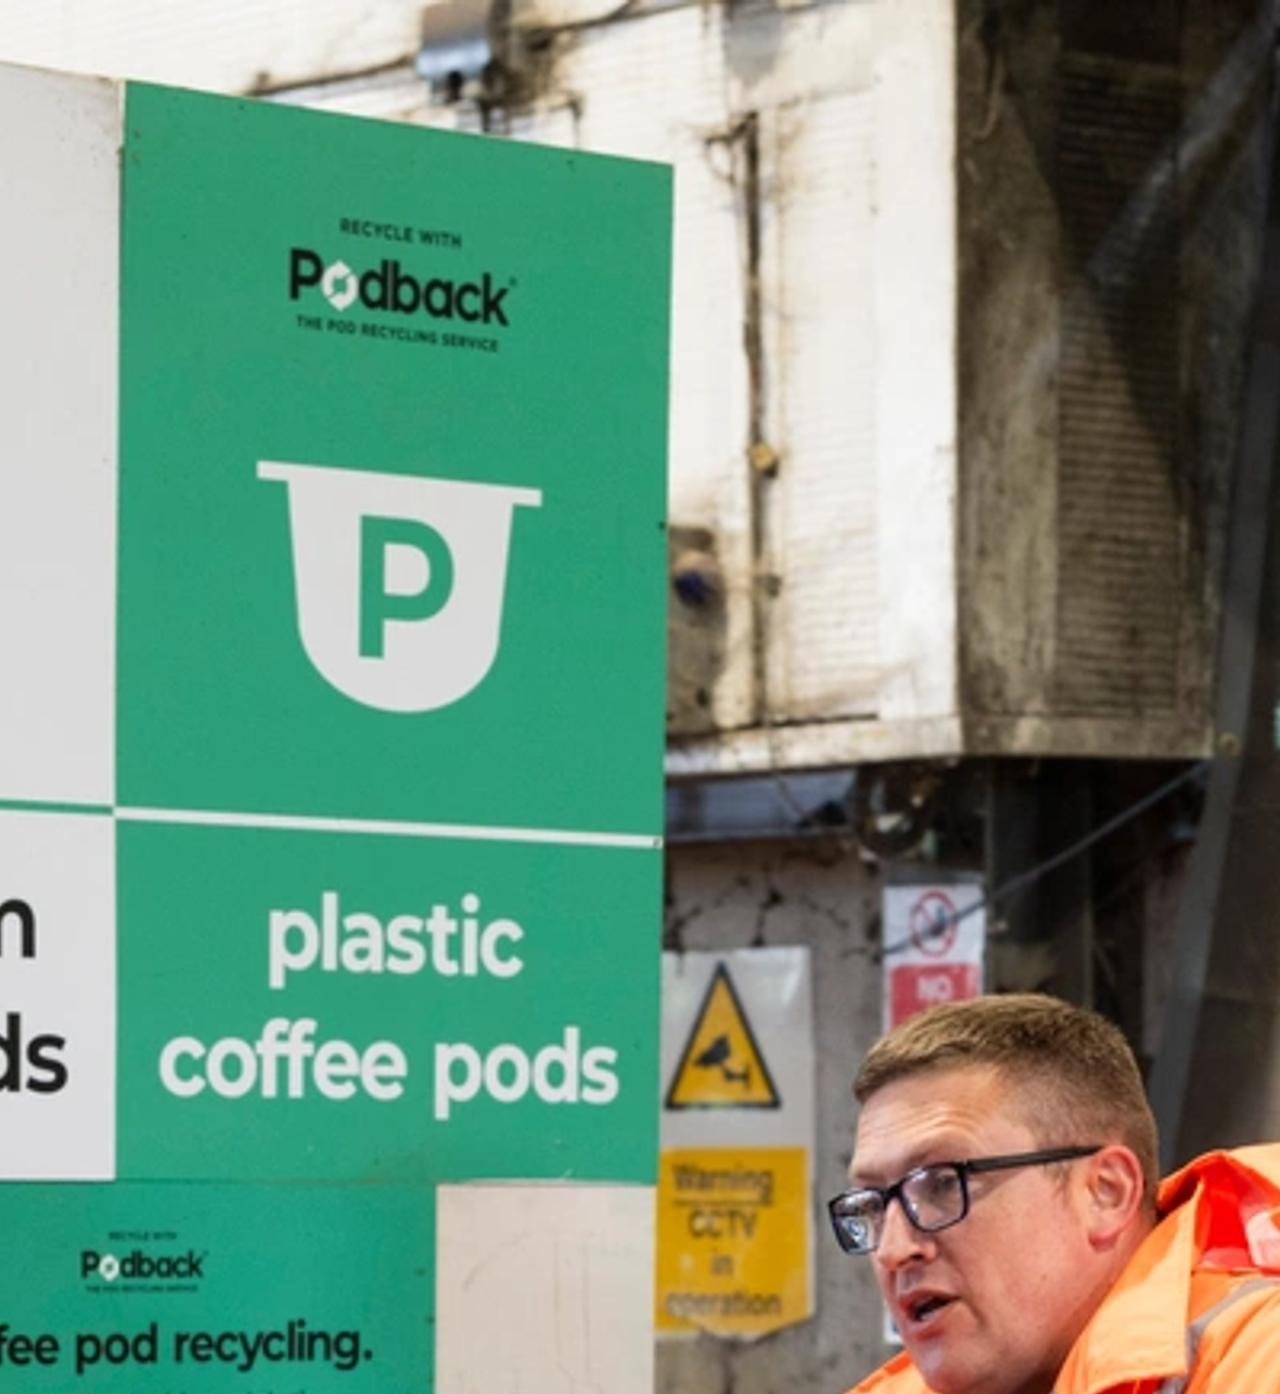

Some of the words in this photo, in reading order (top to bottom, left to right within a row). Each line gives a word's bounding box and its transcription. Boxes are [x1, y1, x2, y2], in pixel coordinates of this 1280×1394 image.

[339, 217, 415, 243] RECYCLE
[420, 230, 462, 248] WITH
[289, 247, 510, 328] Podback
[296, 314, 323, 331] THE
[326, 319, 357, 335] POD
[361, 322, 438, 346] RECYCLING
[441, 332, 499, 353] SERVICE
[358, 513, 455, 660] P
[268, 891, 524, 990] plastic
[158, 1017, 408, 1100] coffee
[434, 1025, 619, 1121] pods
[672, 1164, 775, 1206] Warning
[687, 1209, 758, 1240] CCTV
[81, 1249, 204, 1281] Podback
[709, 1247, 734, 1276] in
[75, 1322, 158, 1373] pod
[173, 1319, 374, 1372] recycling.
